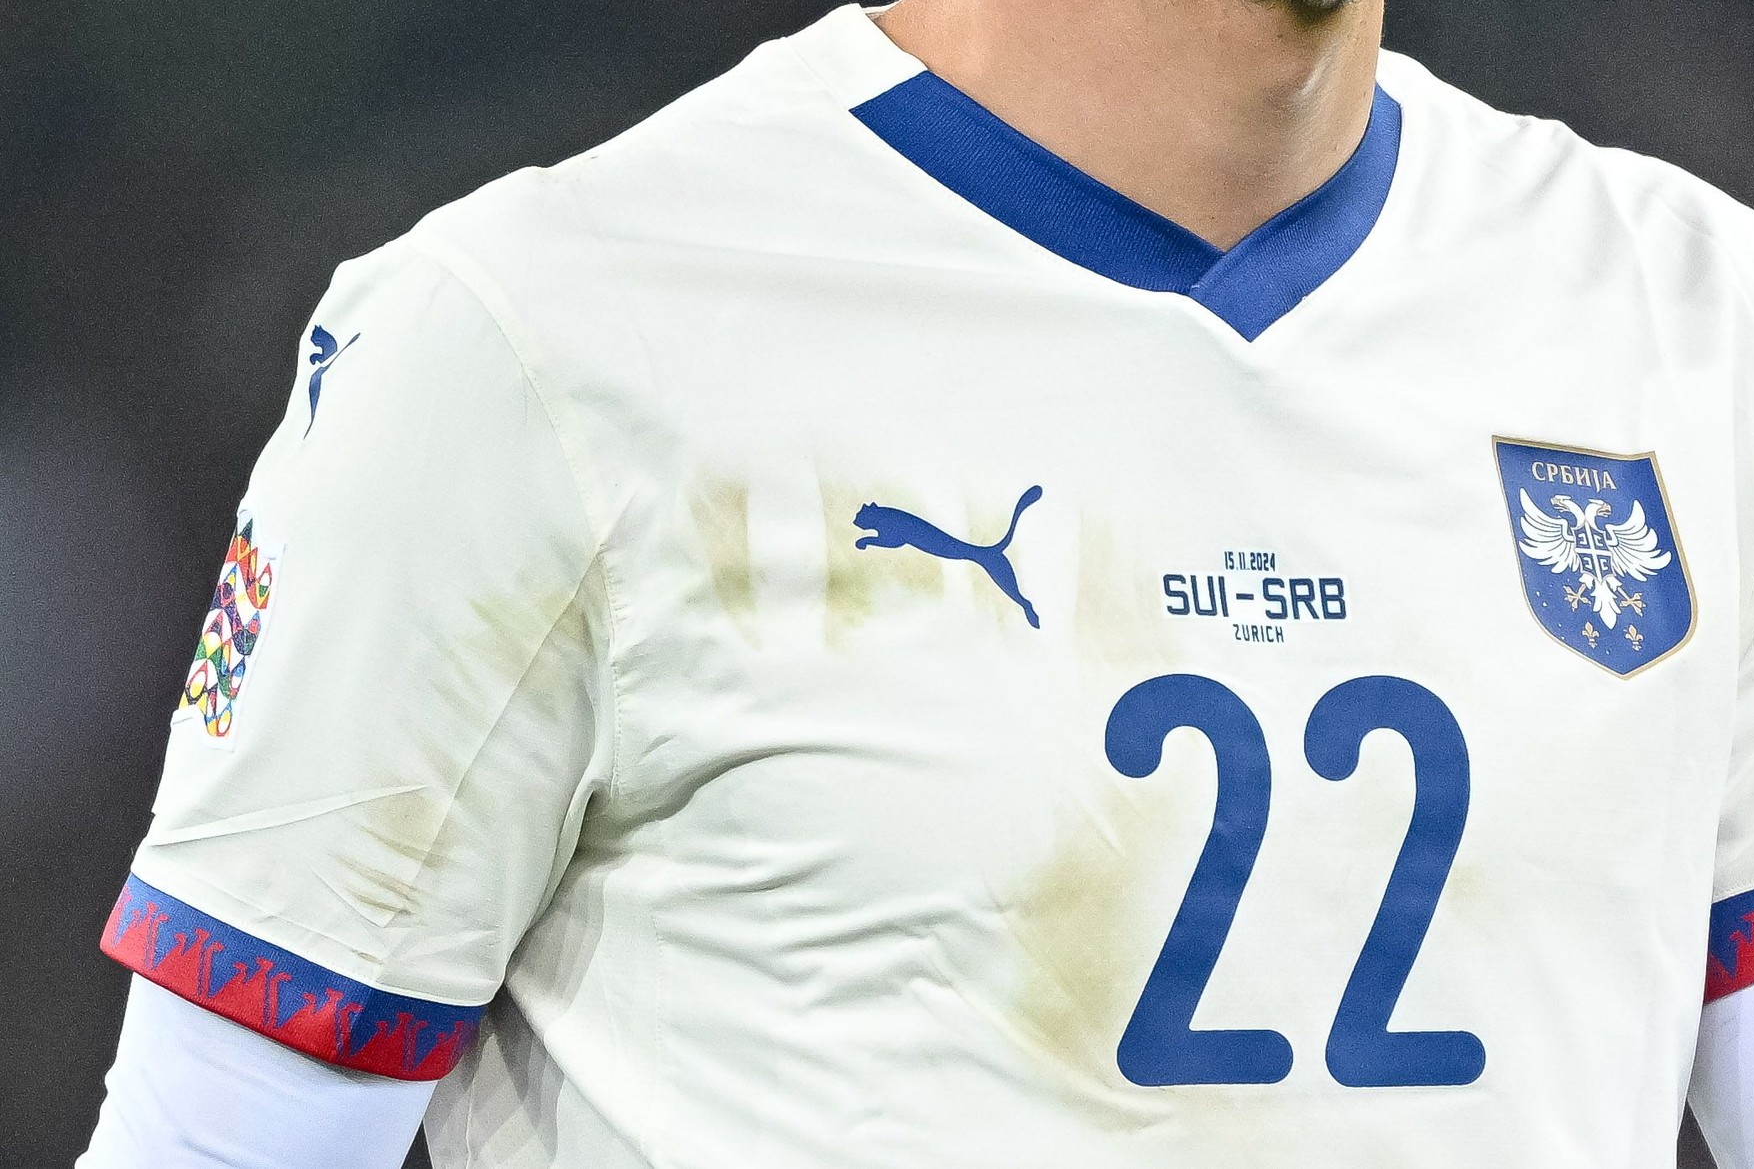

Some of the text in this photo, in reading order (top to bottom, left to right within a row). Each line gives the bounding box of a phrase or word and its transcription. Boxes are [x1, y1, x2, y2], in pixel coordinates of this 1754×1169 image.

[1531, 461, 1617, 493] СРБИЈА
[1224, 551, 1276, 572] 15.11.2024
[1232, 624, 1285, 643] ZURICH
[1104, 673, 1486, 1087] 22
